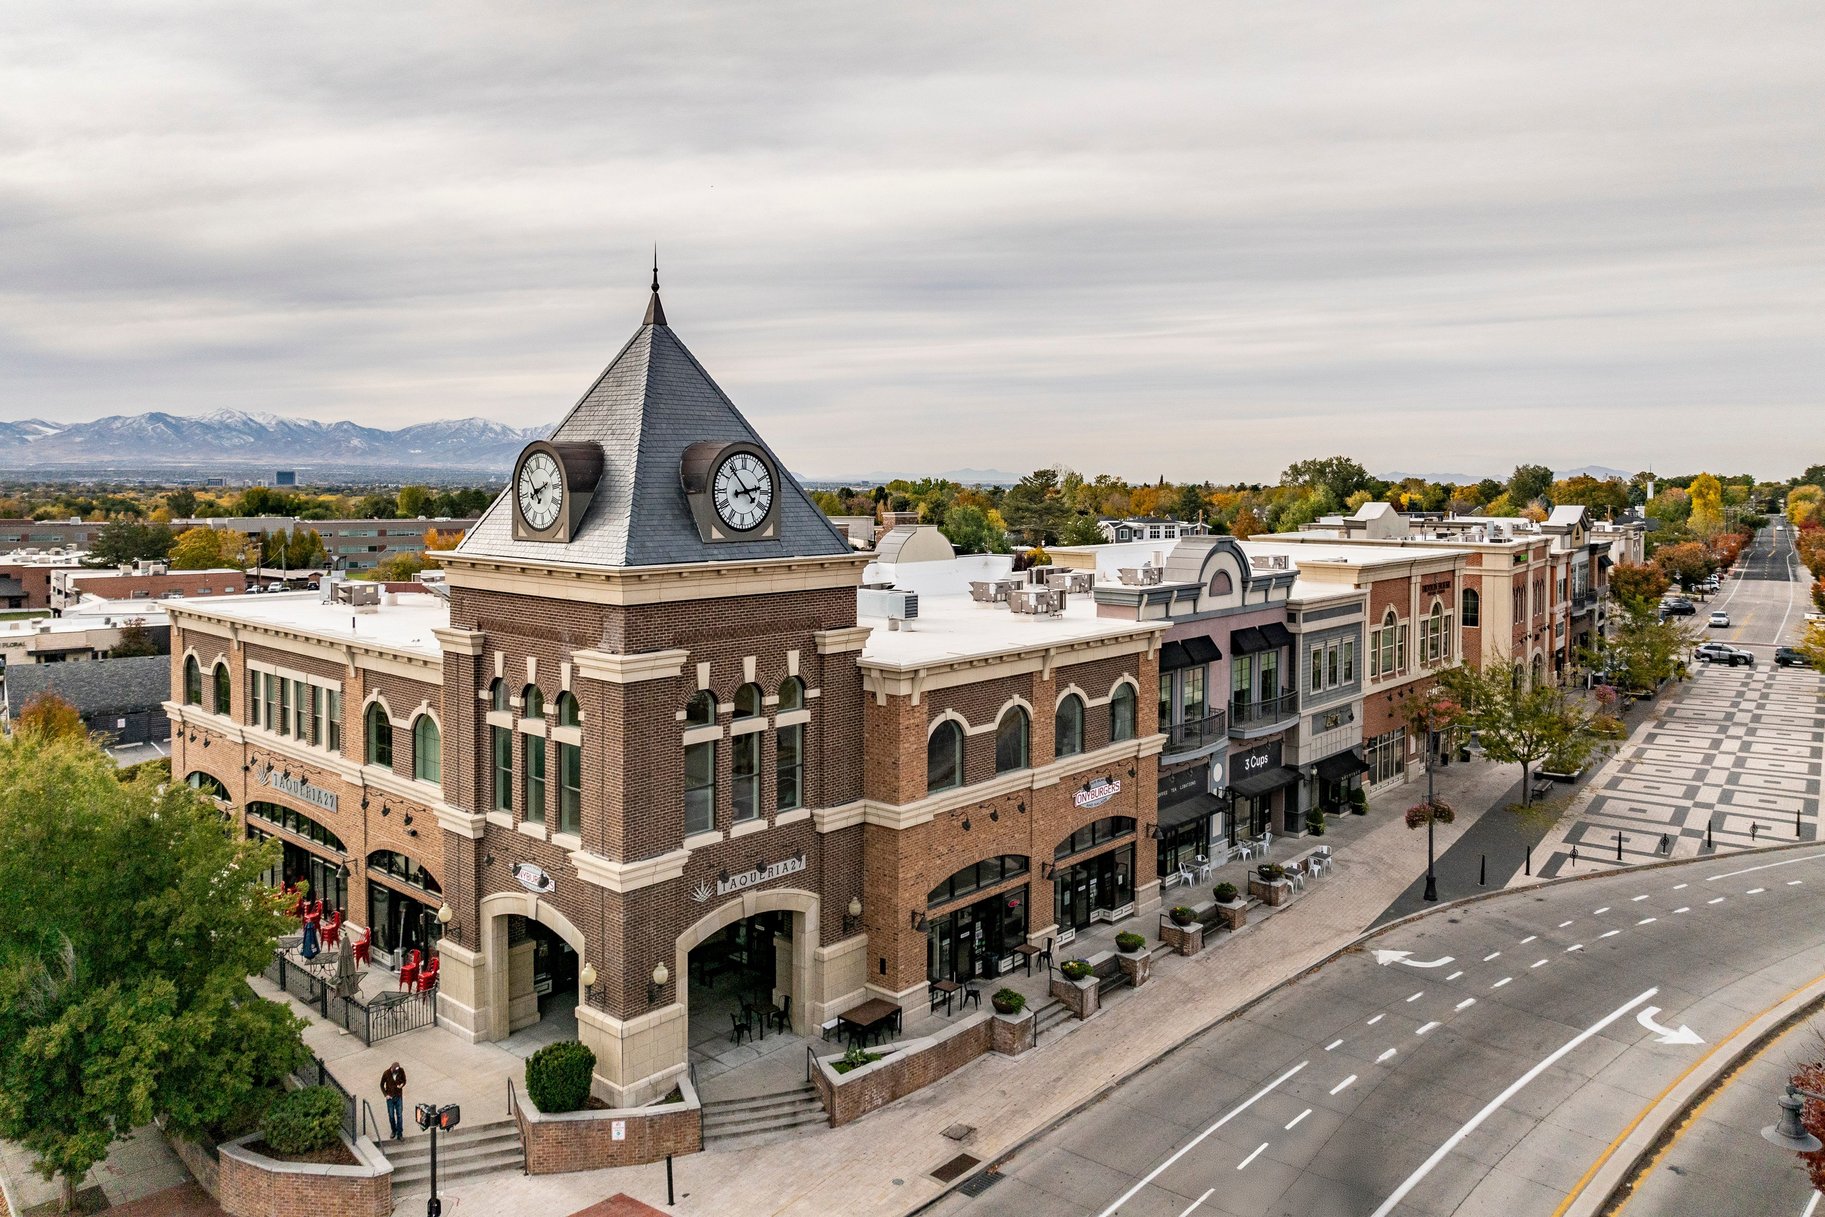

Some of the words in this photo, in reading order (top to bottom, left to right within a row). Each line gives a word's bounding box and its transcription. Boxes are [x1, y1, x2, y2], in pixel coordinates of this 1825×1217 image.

[1244, 758, 1250, 770] 3
[1250, 754, 1268, 768] Cups
[273, 773, 335, 808] TAQUERIA27
[1072, 781, 1120, 807] TONYBURGERS
[721, 859, 803, 892] TAQUERIA27
